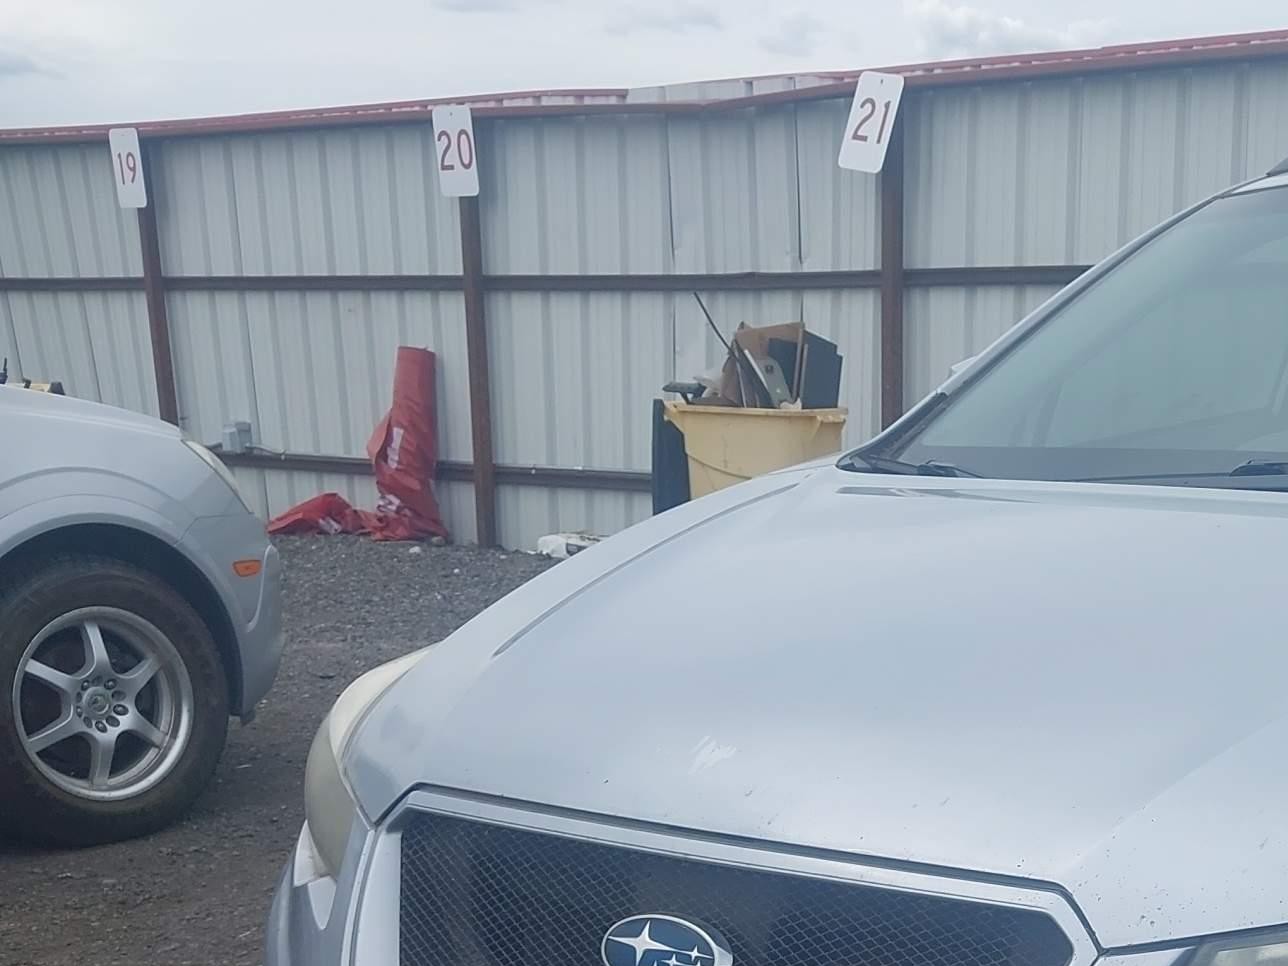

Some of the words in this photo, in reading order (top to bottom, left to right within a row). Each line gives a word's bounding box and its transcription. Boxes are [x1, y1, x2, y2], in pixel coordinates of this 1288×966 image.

[851, 97, 891, 144] 21
[117, 151, 137, 185] 19
[437, 129, 473, 171] 20
